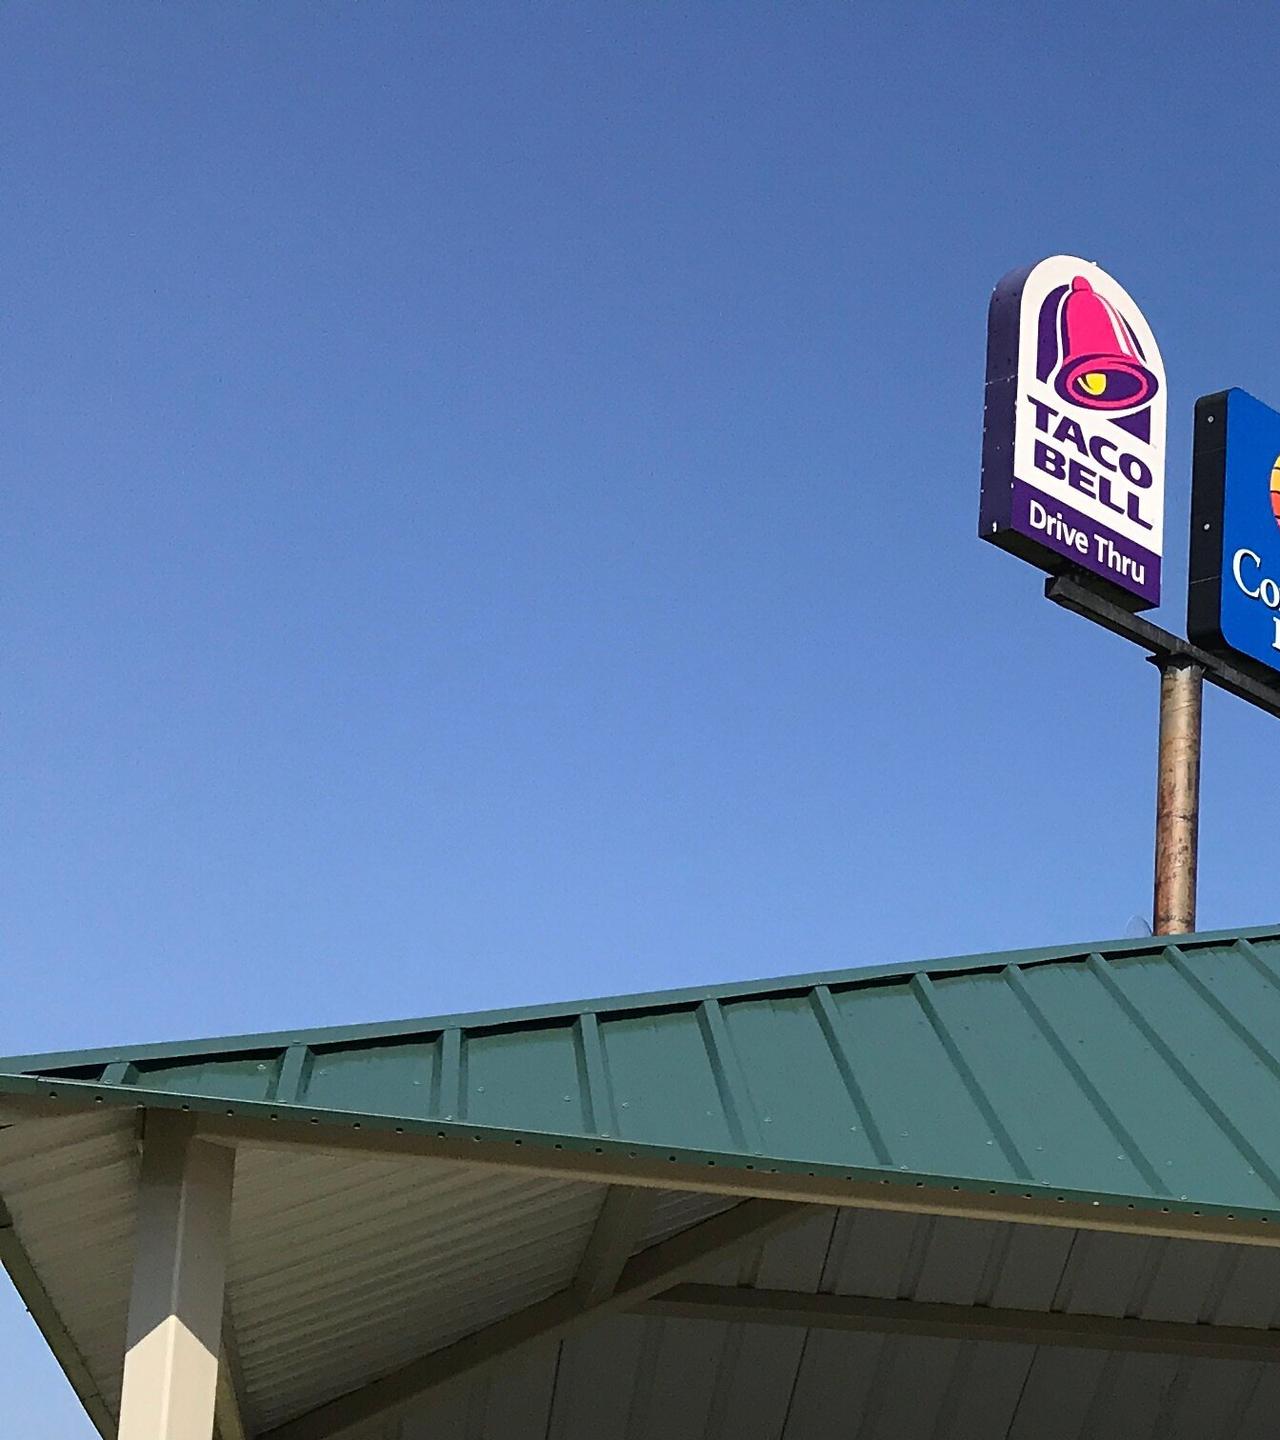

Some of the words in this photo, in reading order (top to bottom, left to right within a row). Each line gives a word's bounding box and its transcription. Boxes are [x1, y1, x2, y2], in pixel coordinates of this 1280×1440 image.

[1027, 394, 1153, 489] TACO
[1034, 438, 1153, 531] BELL
[1029, 499, 1089, 554] Drive
[1093, 533, 1145, 585] Thru
